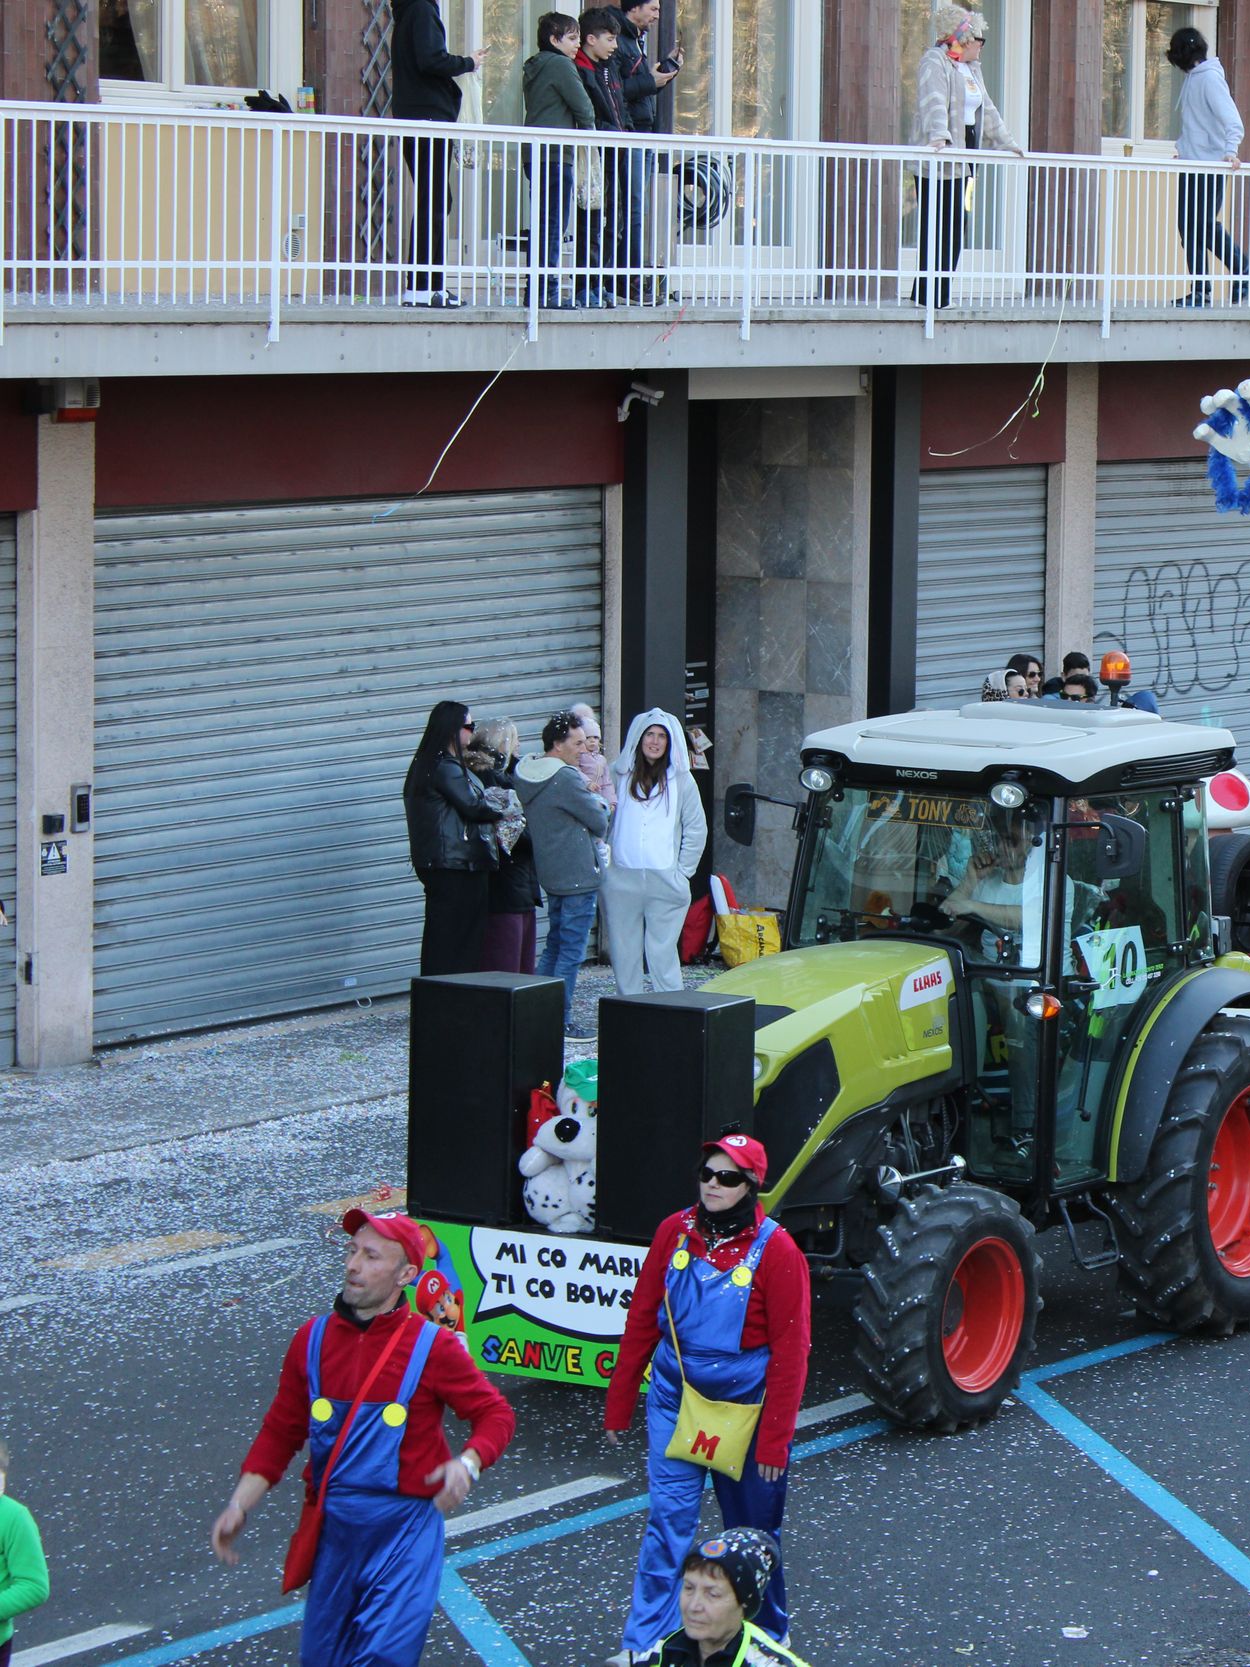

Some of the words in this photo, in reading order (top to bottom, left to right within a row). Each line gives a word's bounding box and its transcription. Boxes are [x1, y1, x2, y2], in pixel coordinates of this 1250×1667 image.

[895, 769, 938, 780] NEXOS
[908, 798, 952, 824] TONY
[1103, 940, 1138, 989] 10
[913, 970, 942, 992] CLAAS
[923, 1025, 943, 1038] NEXOS
[496, 1242, 527, 1264] MI
[537, 1247, 567, 1269] CO
[579, 1252, 641, 1278] MARI
[491, 1272, 515, 1295] TI
[526, 1278, 555, 1299] CO
[567, 1282, 634, 1310] BOWS
[481, 1334, 584, 1376] SANVE
[690, 1430, 721, 1461] M
